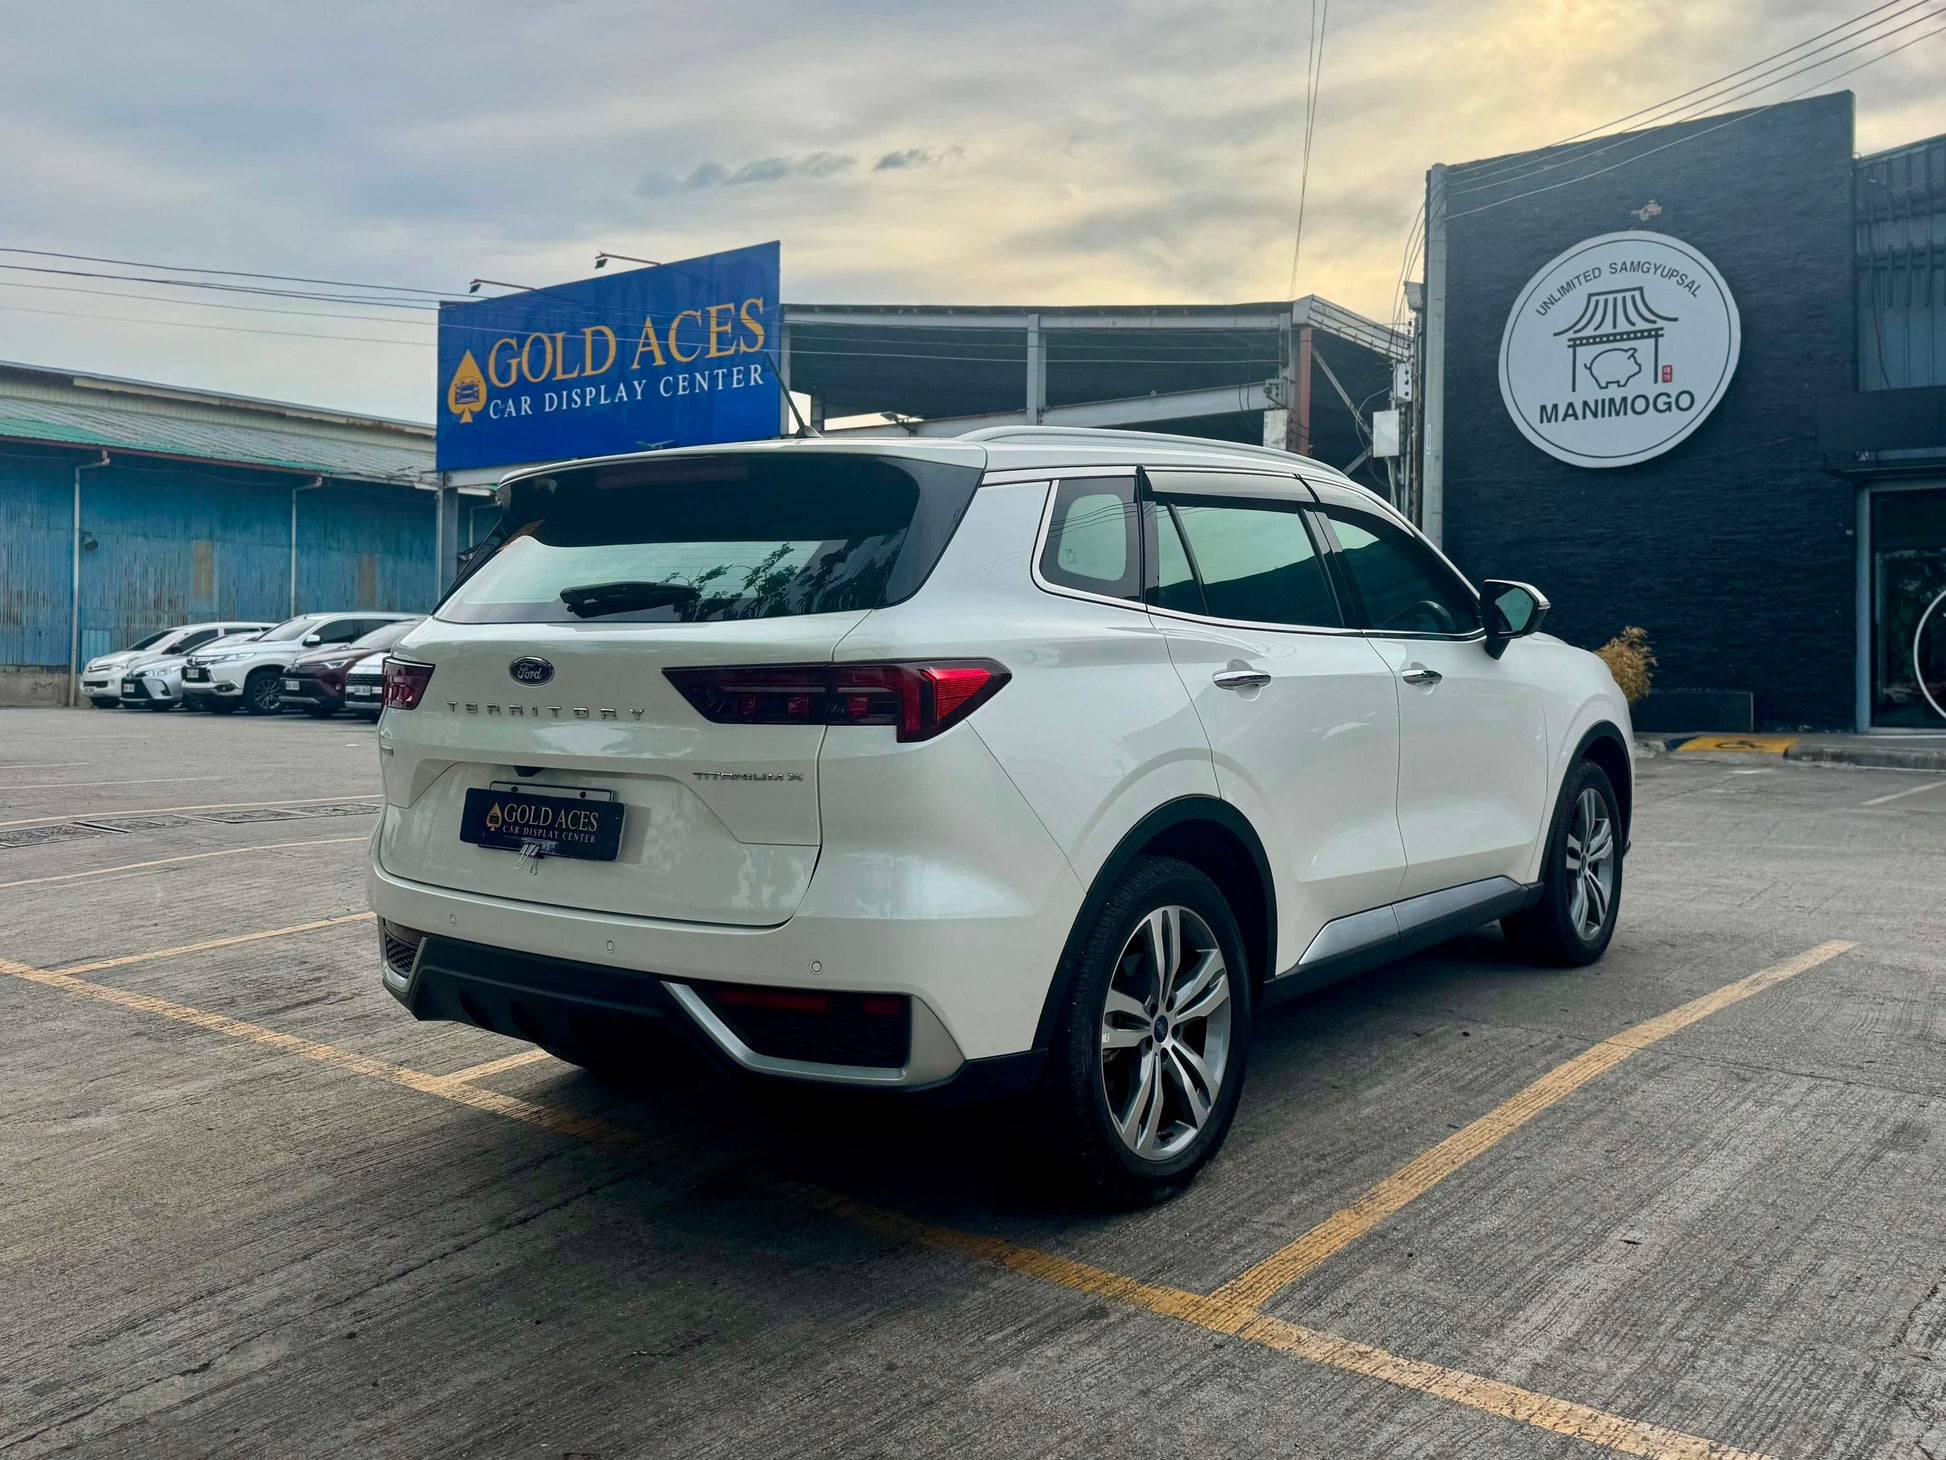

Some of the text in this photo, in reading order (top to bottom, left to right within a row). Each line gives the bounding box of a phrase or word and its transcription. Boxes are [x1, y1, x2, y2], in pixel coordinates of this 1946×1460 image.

[1535, 260, 1702, 317] UNLIMITED SAMGYUPSAL
[488, 297, 766, 388] GOLD ACES
[489, 364, 765, 419] CAR DISPLAY CENTER
[1539, 390, 1695, 424] MANIMOGO
[517, 662, 543, 680] Ford
[447, 701, 645, 721] TERRITORY
[693, 772, 803, 781] TITANIUM X
[504, 803, 599, 832] GOLD ACES
[502, 824, 596, 843] CAR DISPLAY CENTER
